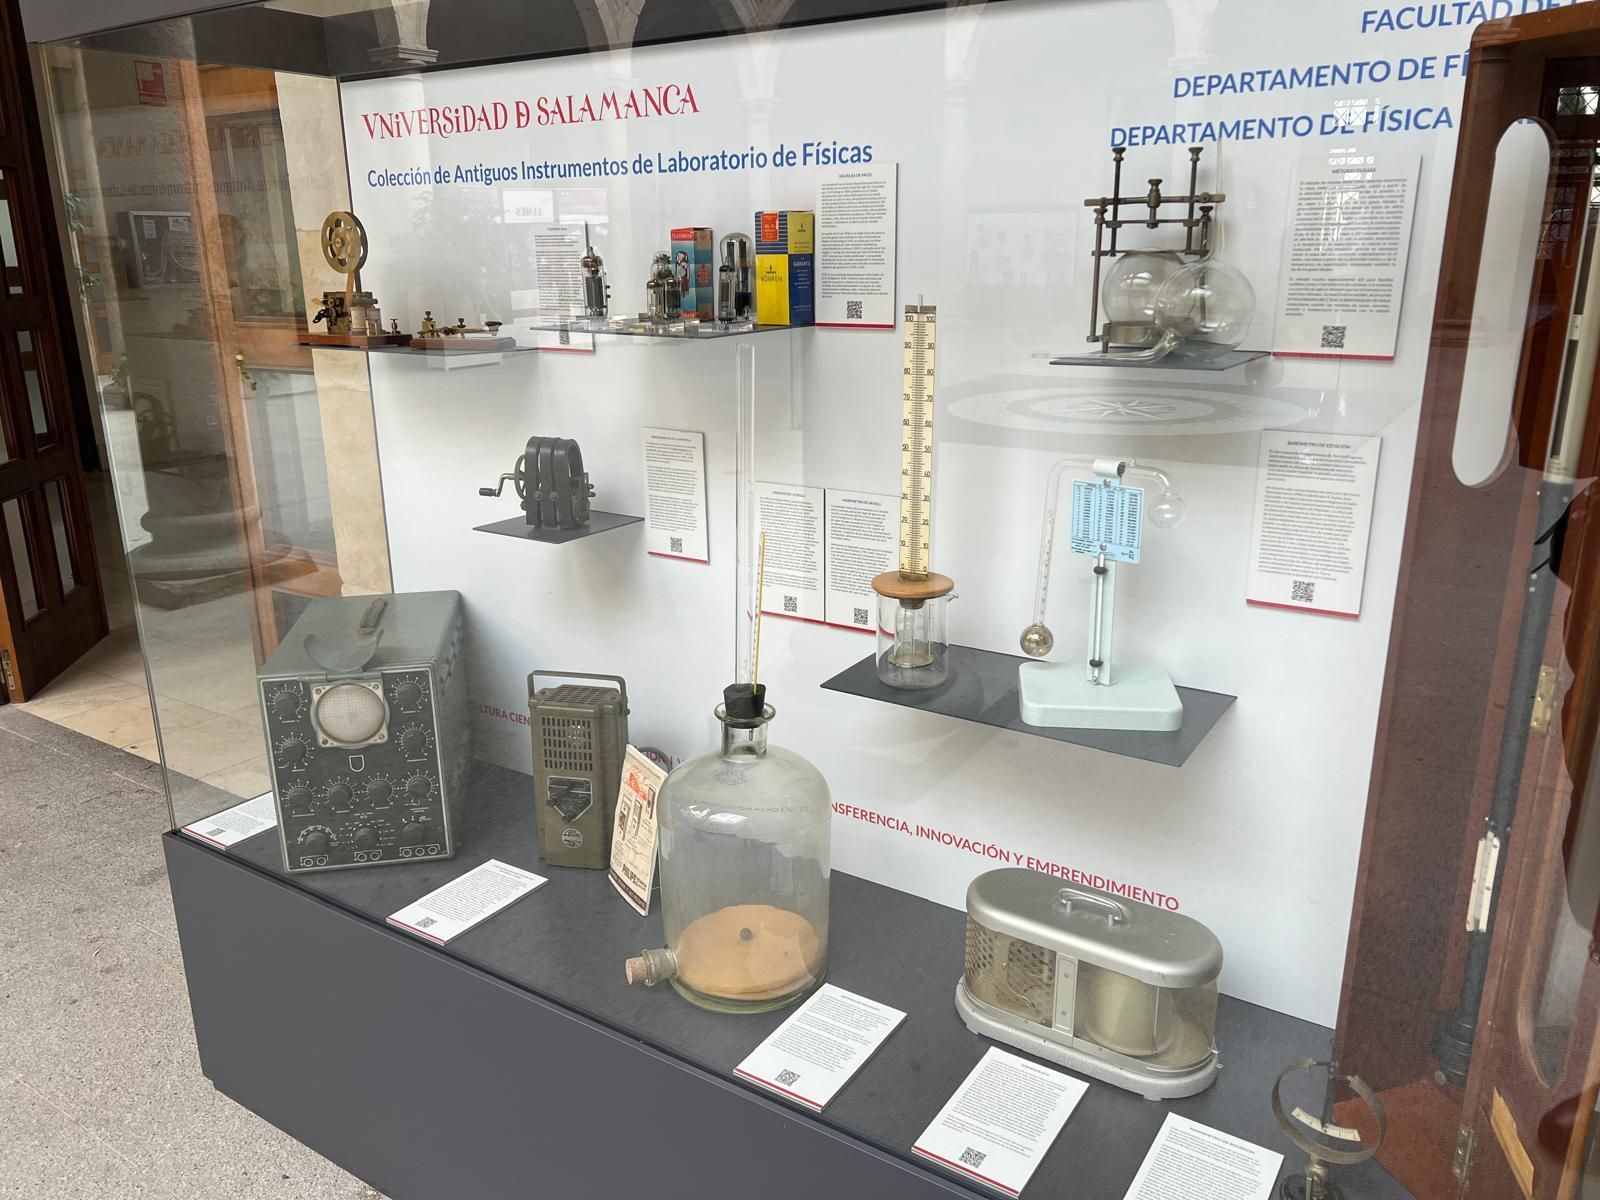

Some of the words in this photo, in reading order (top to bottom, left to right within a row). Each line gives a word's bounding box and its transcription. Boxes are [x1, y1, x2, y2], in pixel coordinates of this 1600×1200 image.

[1361, 0, 1513, 33] FACULTAD
[1173, 61, 1391, 98] DEPARTAMENTO
[1398, 56, 1438, 81] DE
[1443, 48, 1470, 77] FÍ
[537, 83, 700, 125] SALAMANCA
[1110, 116, 1313, 147] DEPARTAMENTO
[1320, 114, 1355, 135] DE
[1362, 105, 1453, 133] FÍSICA
[368, 166, 431, 187] Colección
[434, 166, 450, 184] de
[454, 163, 518, 185] Antiguos
[521, 157, 628, 180] Instrumentos
[632, 153, 652, 175] de
[657, 147, 767, 173] Laboratorio
[772, 144, 797, 168] de
[802, 141, 873, 166] Físicas
[905, 314, 914, 322] 100
[926, 315, 936, 323] 100
[924, 445, 931, 453] 50
[480, 703, 508, 720] LTURA
[510, 712, 531, 726] CIEN
[832, 802, 913, 836] NSFERENCIA,
[916, 825, 1010, 862] INNOVACIÓN
[1013, 852, 1023, 866] Y
[1026, 856, 1179, 911] EMPRENDIMIENTO
